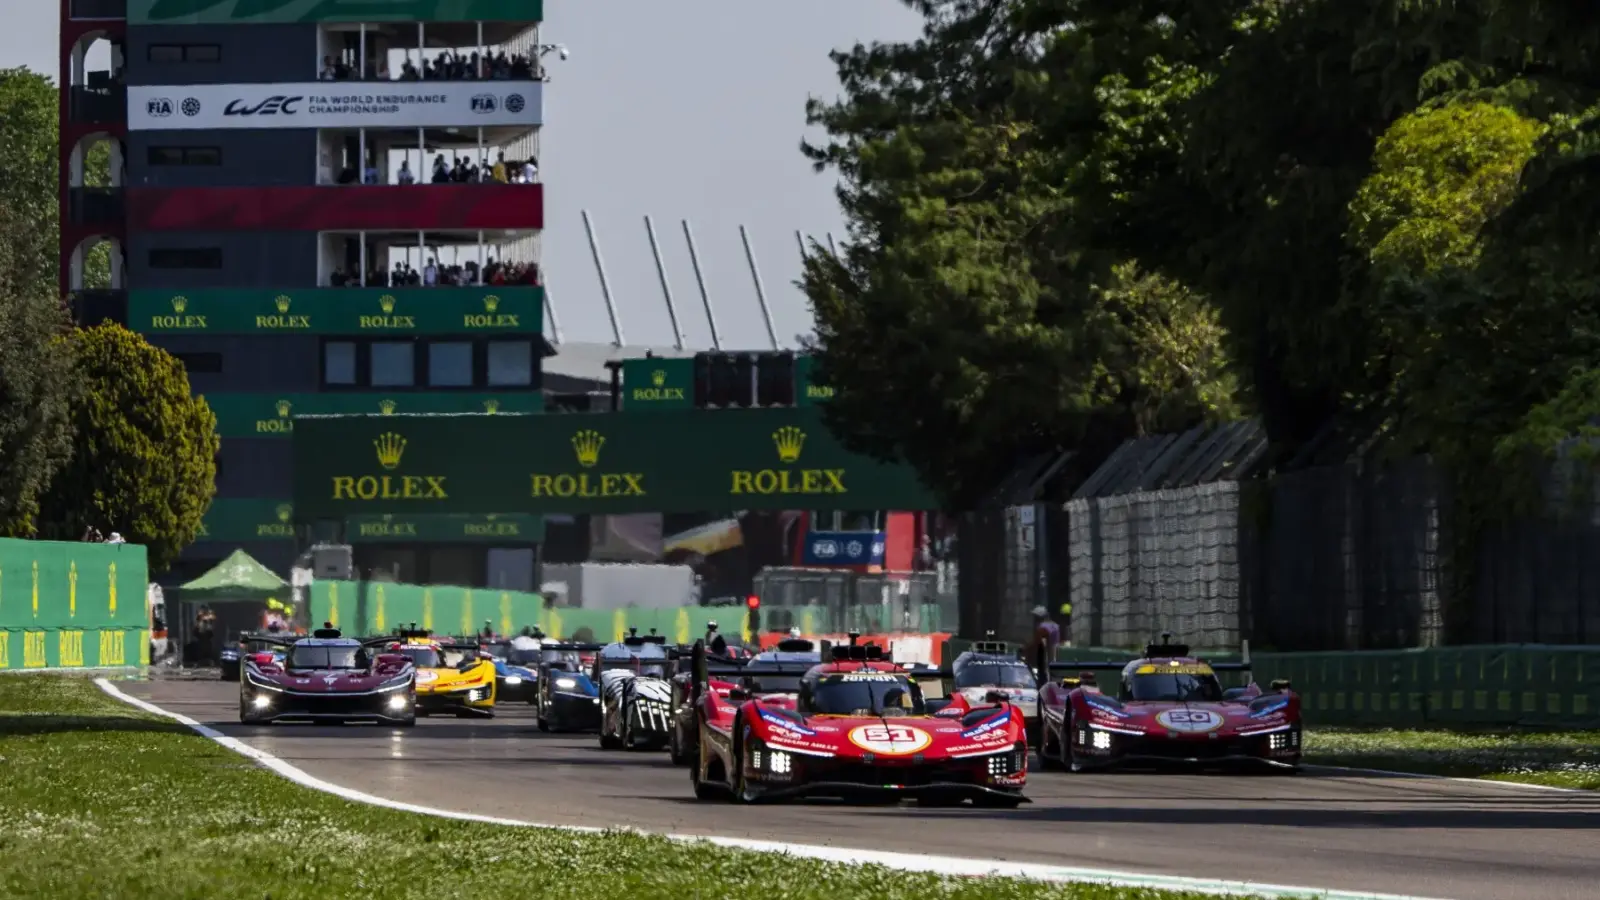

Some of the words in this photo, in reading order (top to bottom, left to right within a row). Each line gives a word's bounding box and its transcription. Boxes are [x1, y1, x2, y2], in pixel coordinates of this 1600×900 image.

[223, 96, 304, 116] WEC
[309, 96, 328, 104] FIA
[332, 95, 373, 104] WORLD
[376, 94, 447, 104] ENDURANCE
[309, 105, 400, 114] CHAMPIONSHIP
[152, 315, 208, 329] ROLEX
[256, 315, 311, 329] ROLEX
[360, 315, 416, 329] ROLEX
[463, 313, 520, 328] ROLEX
[633, 388, 684, 400] ROLEX
[331, 475, 449, 500] ROLEX
[530, 473, 646, 497] ROLEX
[730, 468, 848, 494] ROLEX
[360, 522, 417, 536] ROLEX
[464, 522, 520, 536] ROLEX
[841, 674, 898, 683] Ferrari
[1169, 711, 1211, 723] 50
[864, 728, 915, 742] 51
[945, 743, 983, 752] RICHARD
